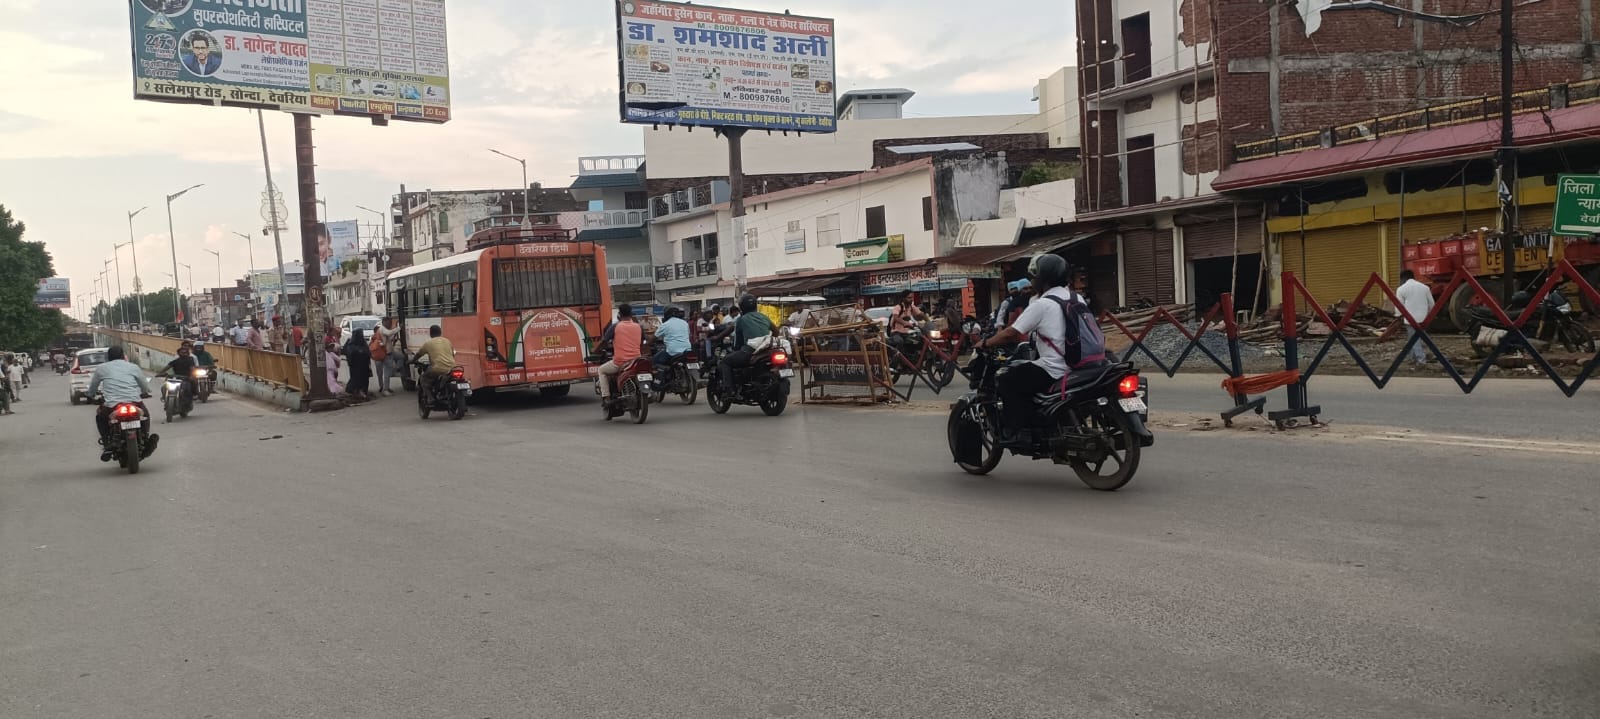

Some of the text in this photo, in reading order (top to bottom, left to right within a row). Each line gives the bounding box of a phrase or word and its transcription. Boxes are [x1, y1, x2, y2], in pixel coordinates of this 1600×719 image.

[263, 14, 304, 33] हास्पिटल
[243, 35, 277, 55] नागेन्द्र
[279, 41, 307, 57] यादव
[626, 22, 829, 57] डा. शमशाद अली
[154, 81, 202, 98] सलेमपुर
[268, 90, 307, 105] देवरिया
[739, 93, 790, 104] 8009876806
[1563, 178, 1595, 194] जिला
[519, 244, 548, 255] देवरिया
